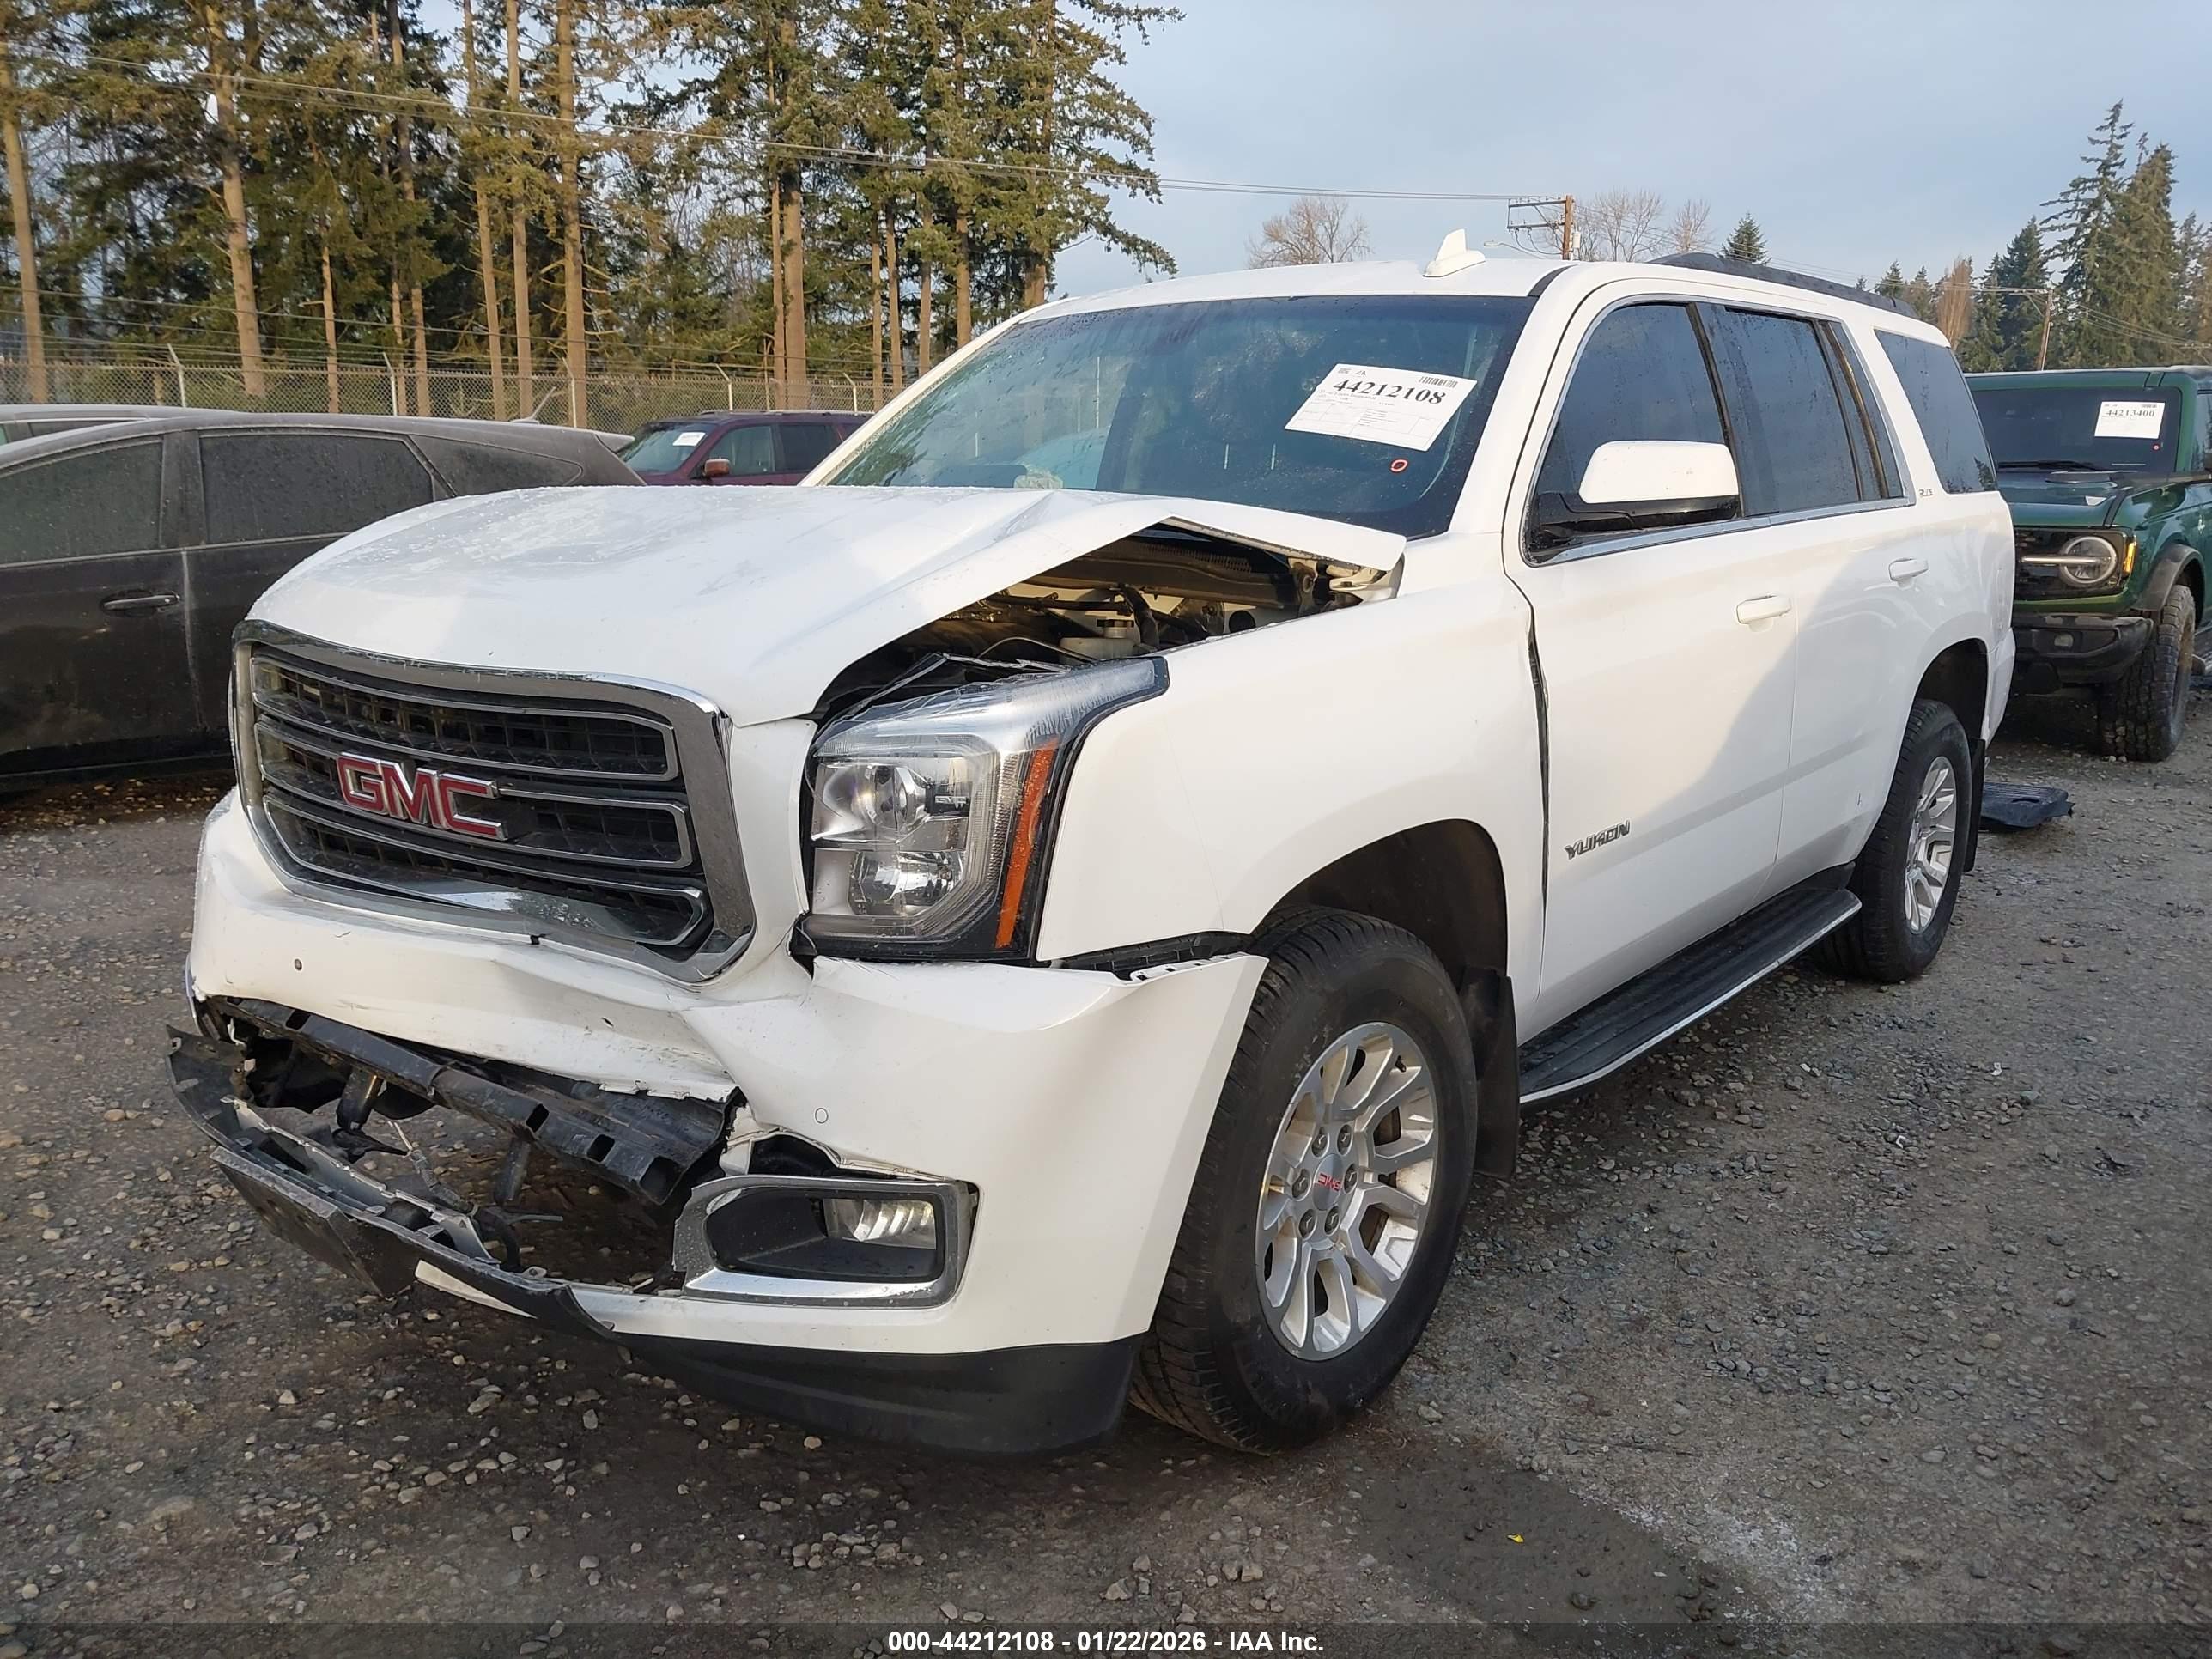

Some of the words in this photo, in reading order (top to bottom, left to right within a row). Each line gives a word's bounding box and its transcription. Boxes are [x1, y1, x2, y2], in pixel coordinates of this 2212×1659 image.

[1333, 379, 1446, 404] 44212108
[2106, 409, 2155, 417] 44213400
[336, 751, 507, 841] GMC
[1564, 820, 1631, 860] YUKON
